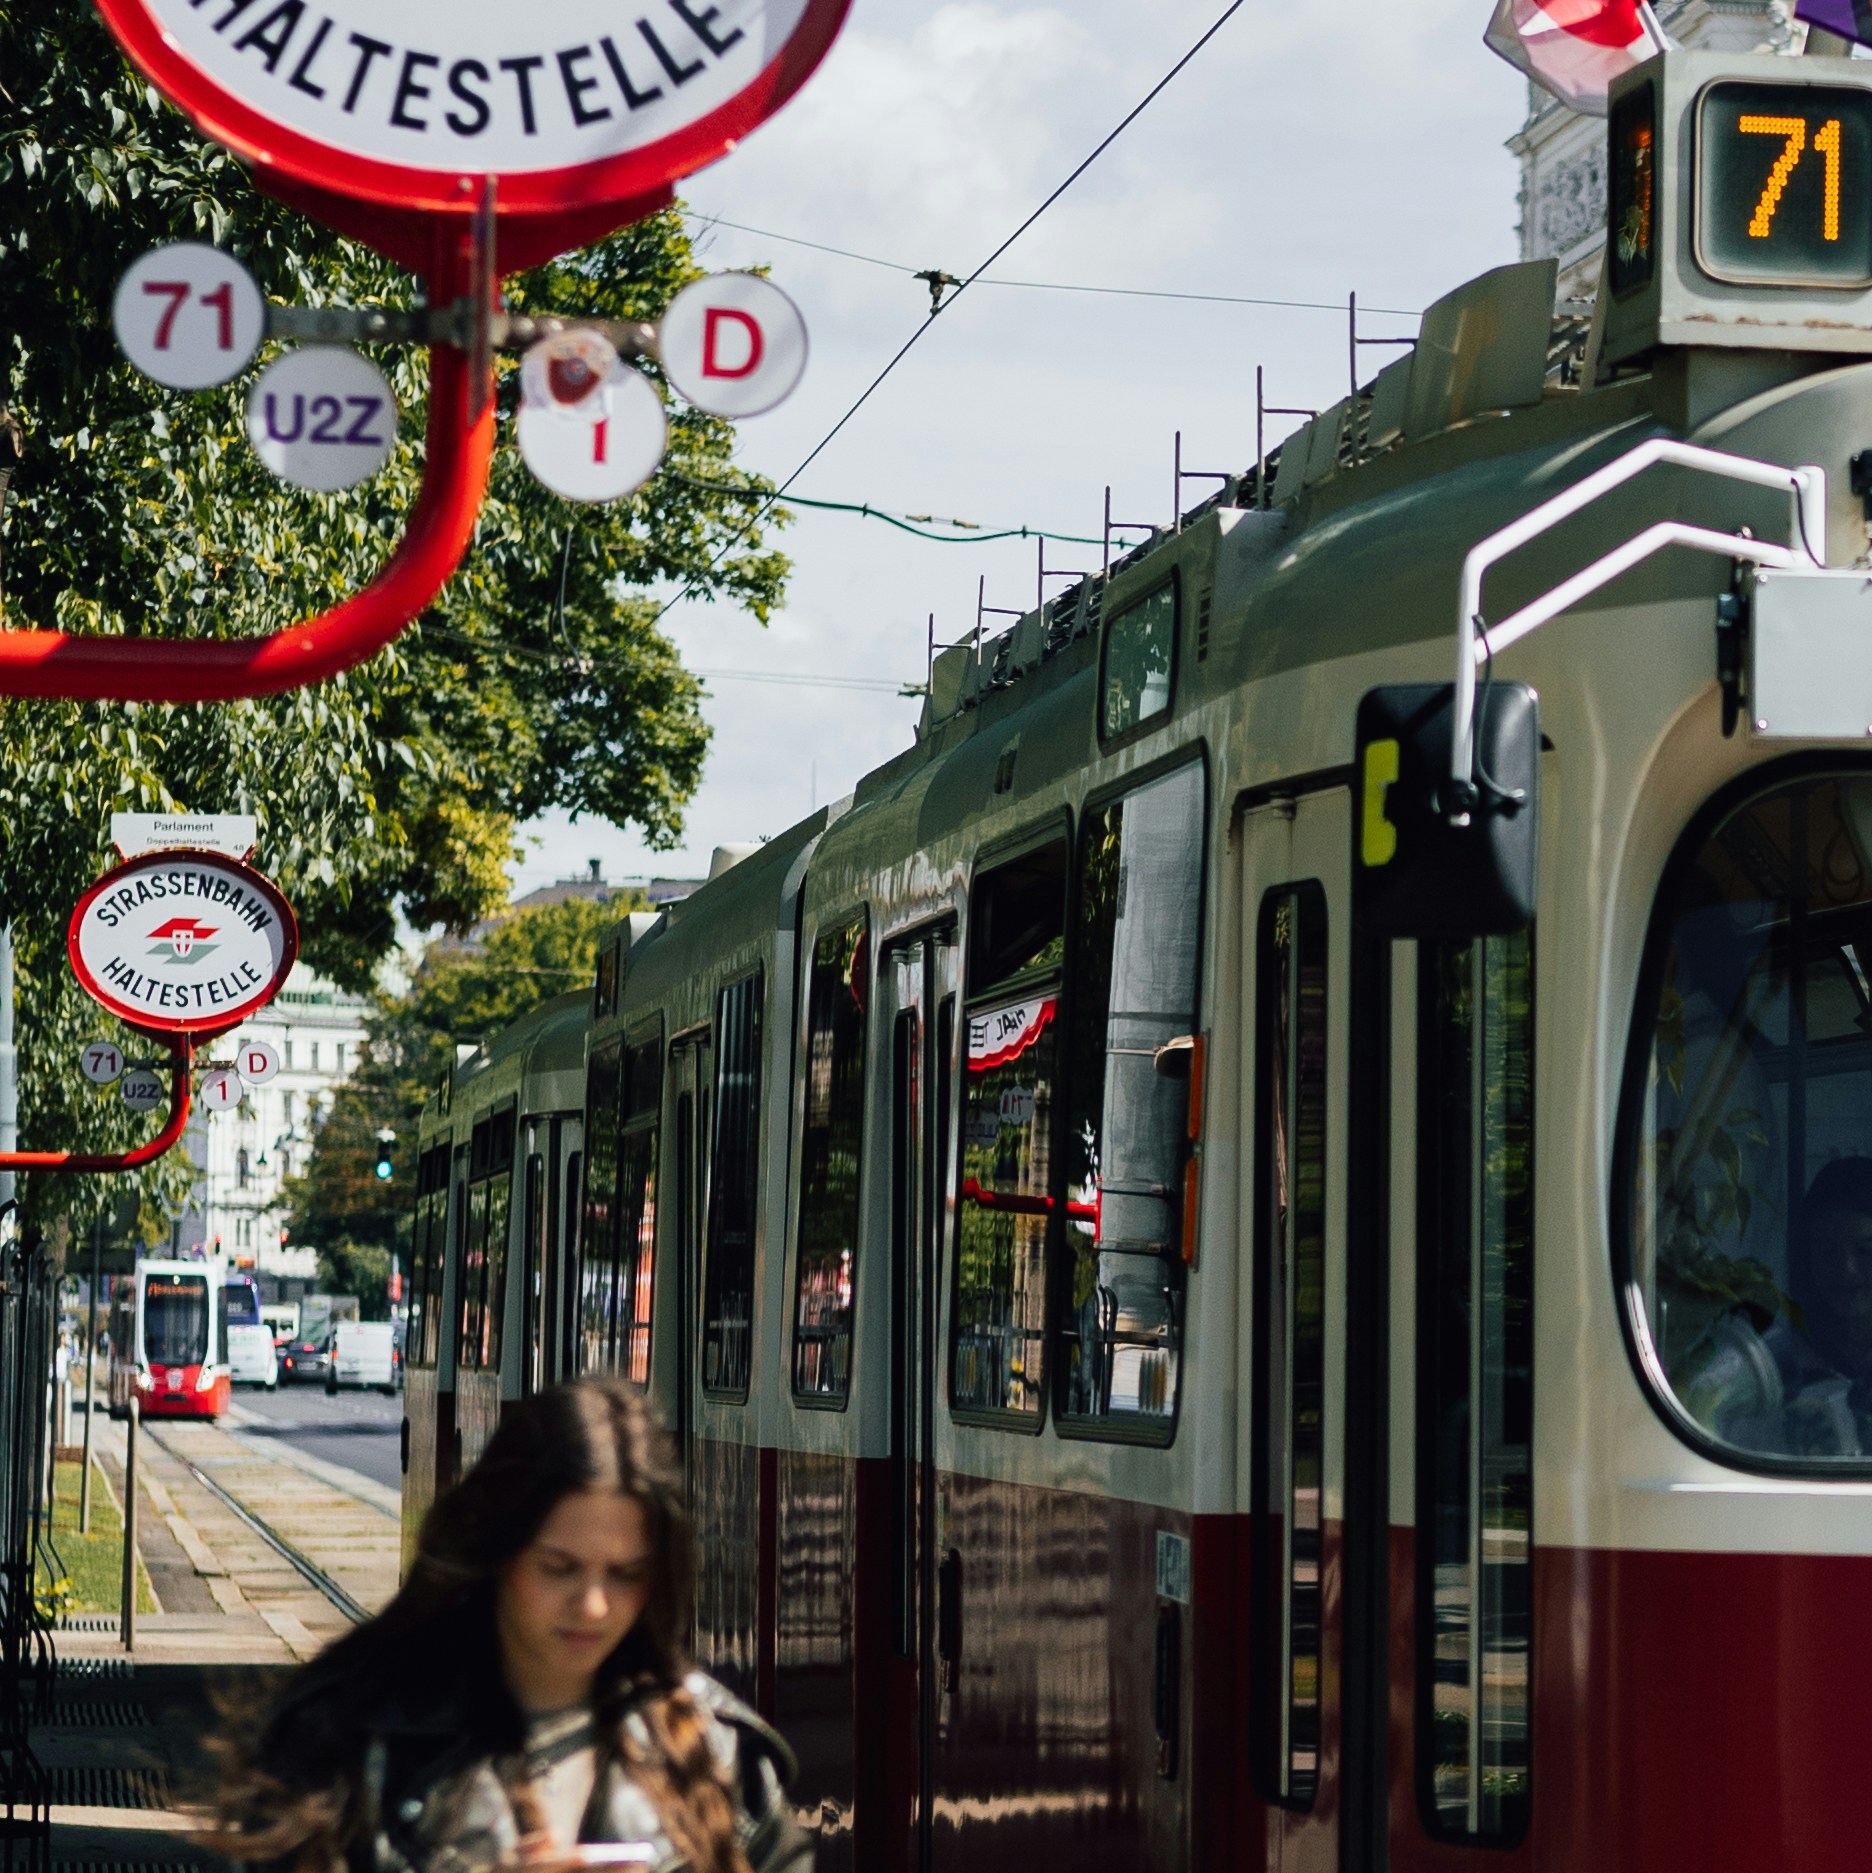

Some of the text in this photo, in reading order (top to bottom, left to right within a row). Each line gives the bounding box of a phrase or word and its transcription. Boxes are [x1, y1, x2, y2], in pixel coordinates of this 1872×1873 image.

[1739, 115, 1841, 241] 71
[142, 281, 235, 351] 71
[701, 306, 764, 381] D
[263, 393, 384, 449] U2Z
[153, 820, 214, 833] Parlament
[96, 871, 273, 934] STRASSENBAHN
[102, 955, 263, 1008] HALTESTELLE
[89, 1051, 117, 1074] 71
[248, 1052, 268, 1074] D
[123, 1083, 159, 1100] U2Z
[217, 1080, 227, 1102] 1
